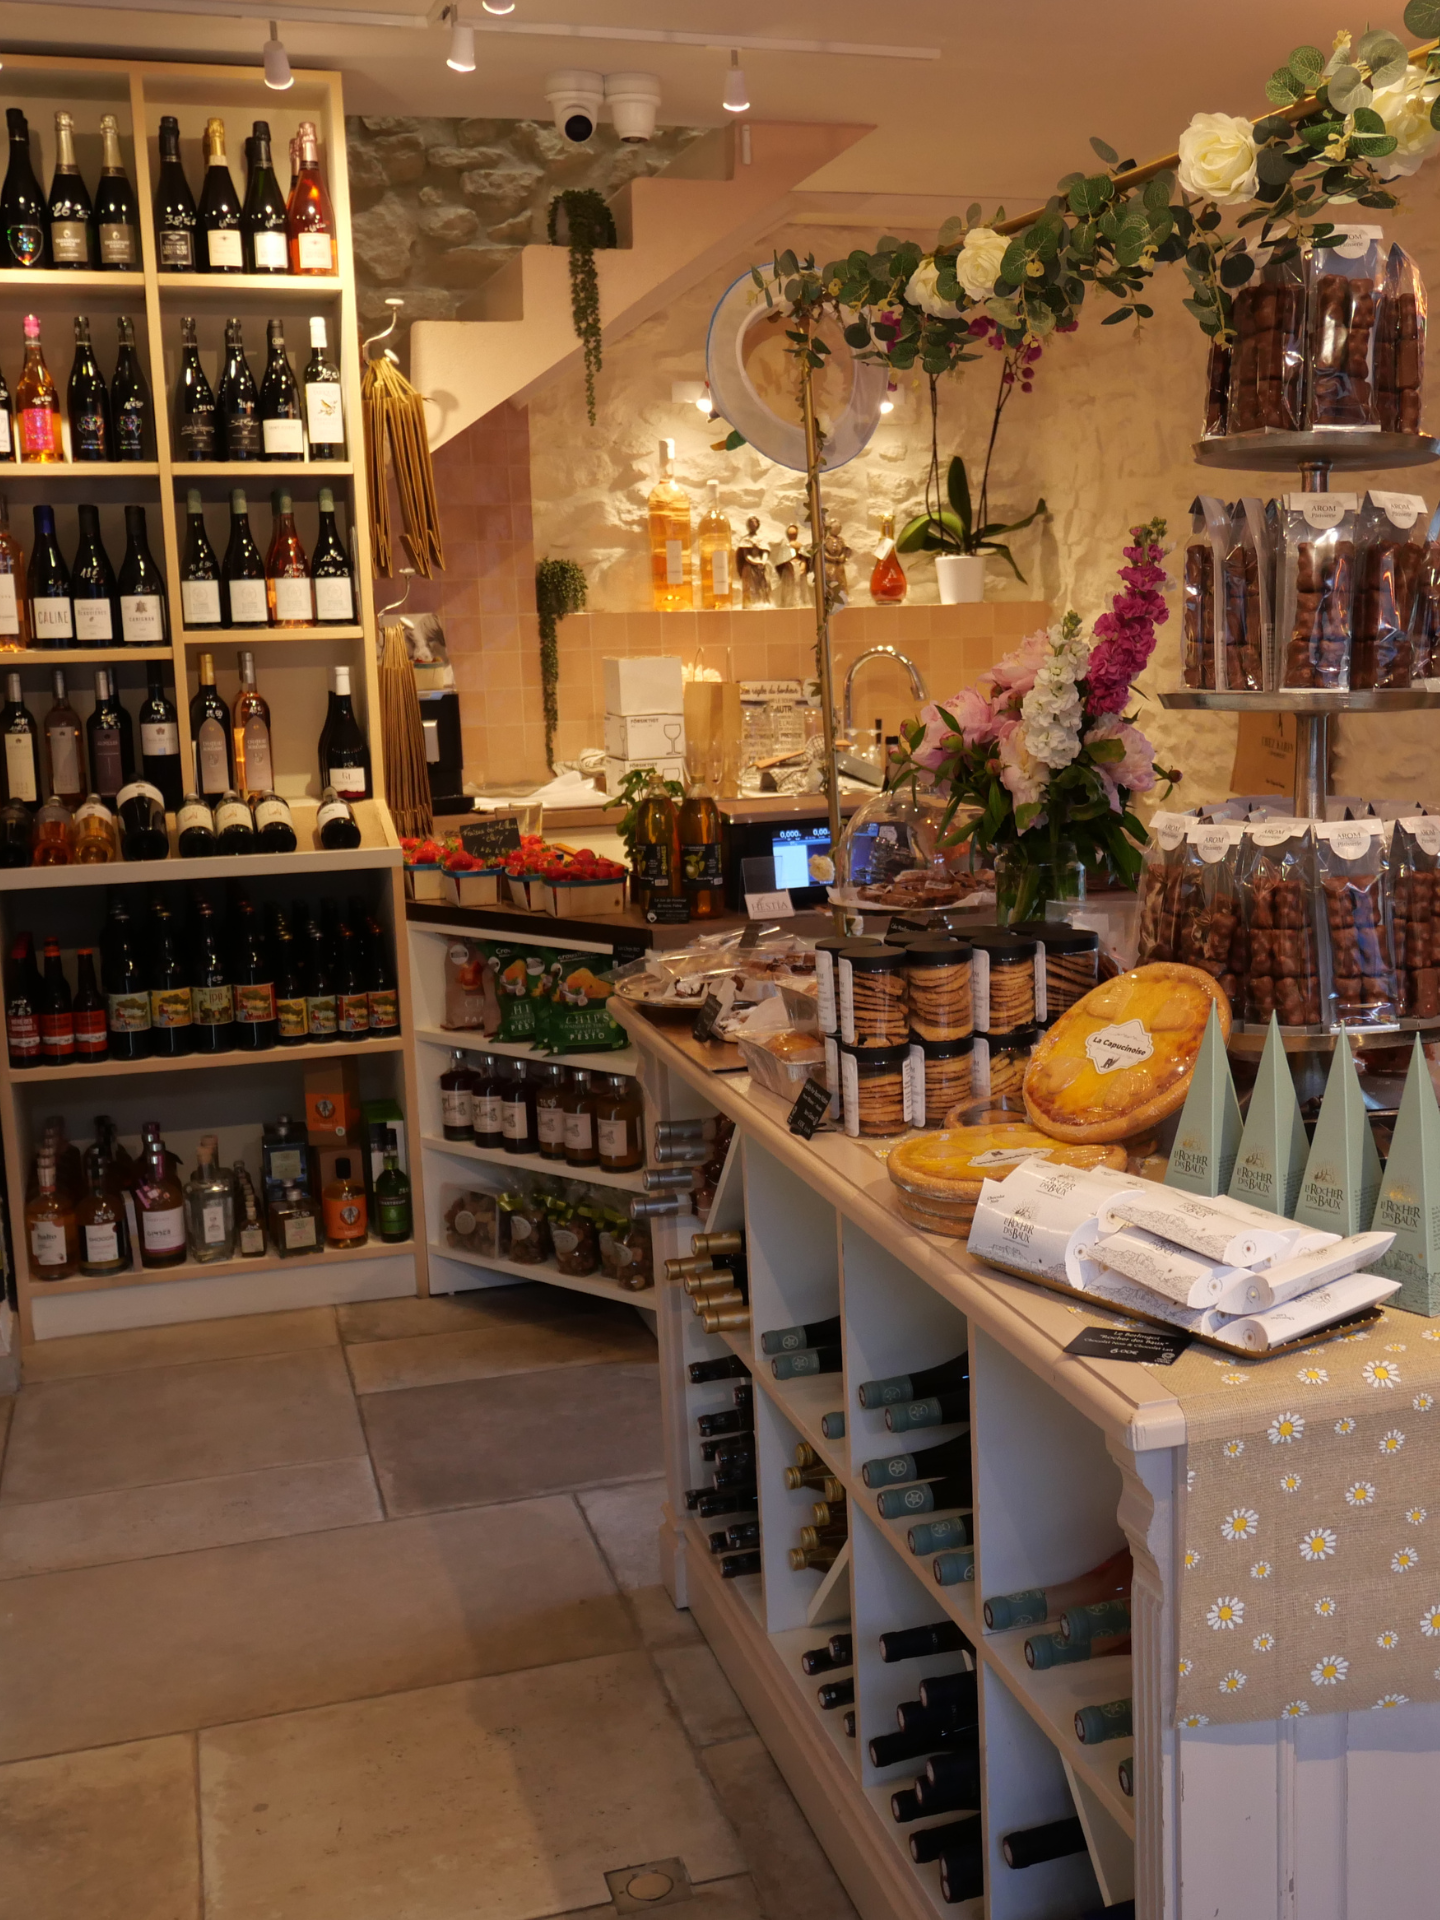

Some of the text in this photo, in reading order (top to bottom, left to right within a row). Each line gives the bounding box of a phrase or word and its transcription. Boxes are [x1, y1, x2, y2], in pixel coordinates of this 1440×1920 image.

[1311, 504, 1337, 512] AROM
[1390, 502, 1411, 510] AROM
[1163, 824, 1181, 833] AROM
[1337, 832, 1362, 840] AROM
[1204, 836, 1225, 845] AROM
[1337, 841, 1362, 849] Pâtisserie
[751, 901, 788, 912] HESTIA
[569, 1032, 606, 1041] PESTO
[1092, 1036, 1147, 1056] La Capucinoise
[1178, 1149, 1209, 1168] ROCHER
[1184, 1160, 1206, 1176] BAUX
[1241, 1165, 1274, 1185] ROCHER
[1248, 1178, 1271, 1194] BAUX
[1310, 1183, 1345, 1201] ROCHER
[1317, 1195, 1342, 1211] BAUX
[1385, 1199, 1422, 1219] ROCHER
[1393, 1212, 1419, 1229] BAUX
[1012, 1227, 1032, 1244] BAUX
